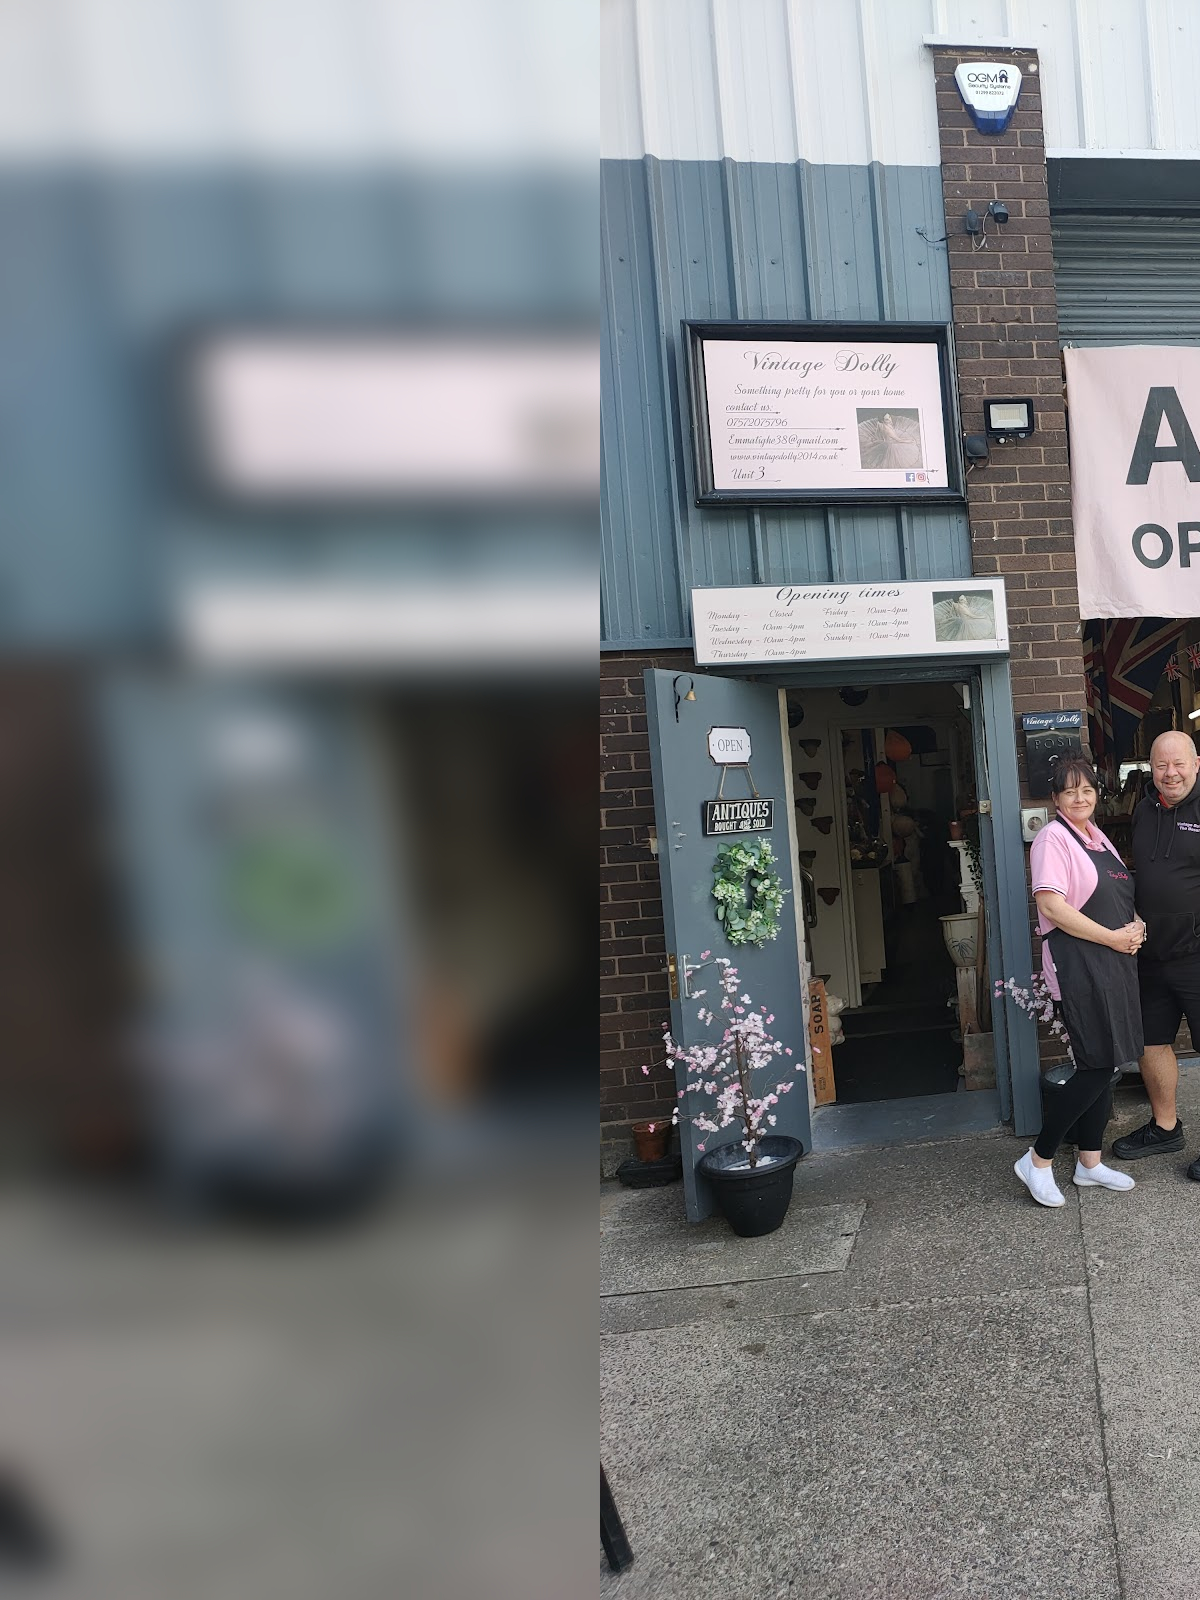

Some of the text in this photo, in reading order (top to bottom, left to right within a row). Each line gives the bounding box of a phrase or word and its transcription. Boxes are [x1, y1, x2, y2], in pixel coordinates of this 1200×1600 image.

[967, 73, 998, 83] OGM
[743, 349, 900, 379] Vintage Dolly
[734, 384, 782, 399] Something
[784, 386, 811, 399] pretty
[812, 386, 827, 399] for
[829, 390, 846, 399] you
[861, 389, 880, 400] your
[883, 387, 906, 397] home
[725, 402, 757, 412] contact
[726, 418, 788, 427] 07572075796
[731, 466, 765, 480] Unit 3
[776, 586, 905, 607] Opening times
[707, 610, 740, 621] Monday
[769, 609, 794, 618] Closed
[822, 607, 849, 617] Friday
[709, 624, 740, 634] Tuesday
[822, 620, 857, 630] Saturday
[710, 636, 753, 646] Wednesday
[823, 632, 853, 643] Sunday
[711, 649, 748, 660] Thursday
[1022, 714, 1081, 727] Vintage Dolly
[717, 738, 744, 752] OPEN
[1034, 736, 1073, 750] POST
[712, 801, 769, 820] ANTIQUES
[714, 821, 738, 832] BOUGHT
[752, 818, 766, 829] SOLD
[811, 994, 824, 1034] SOAP
